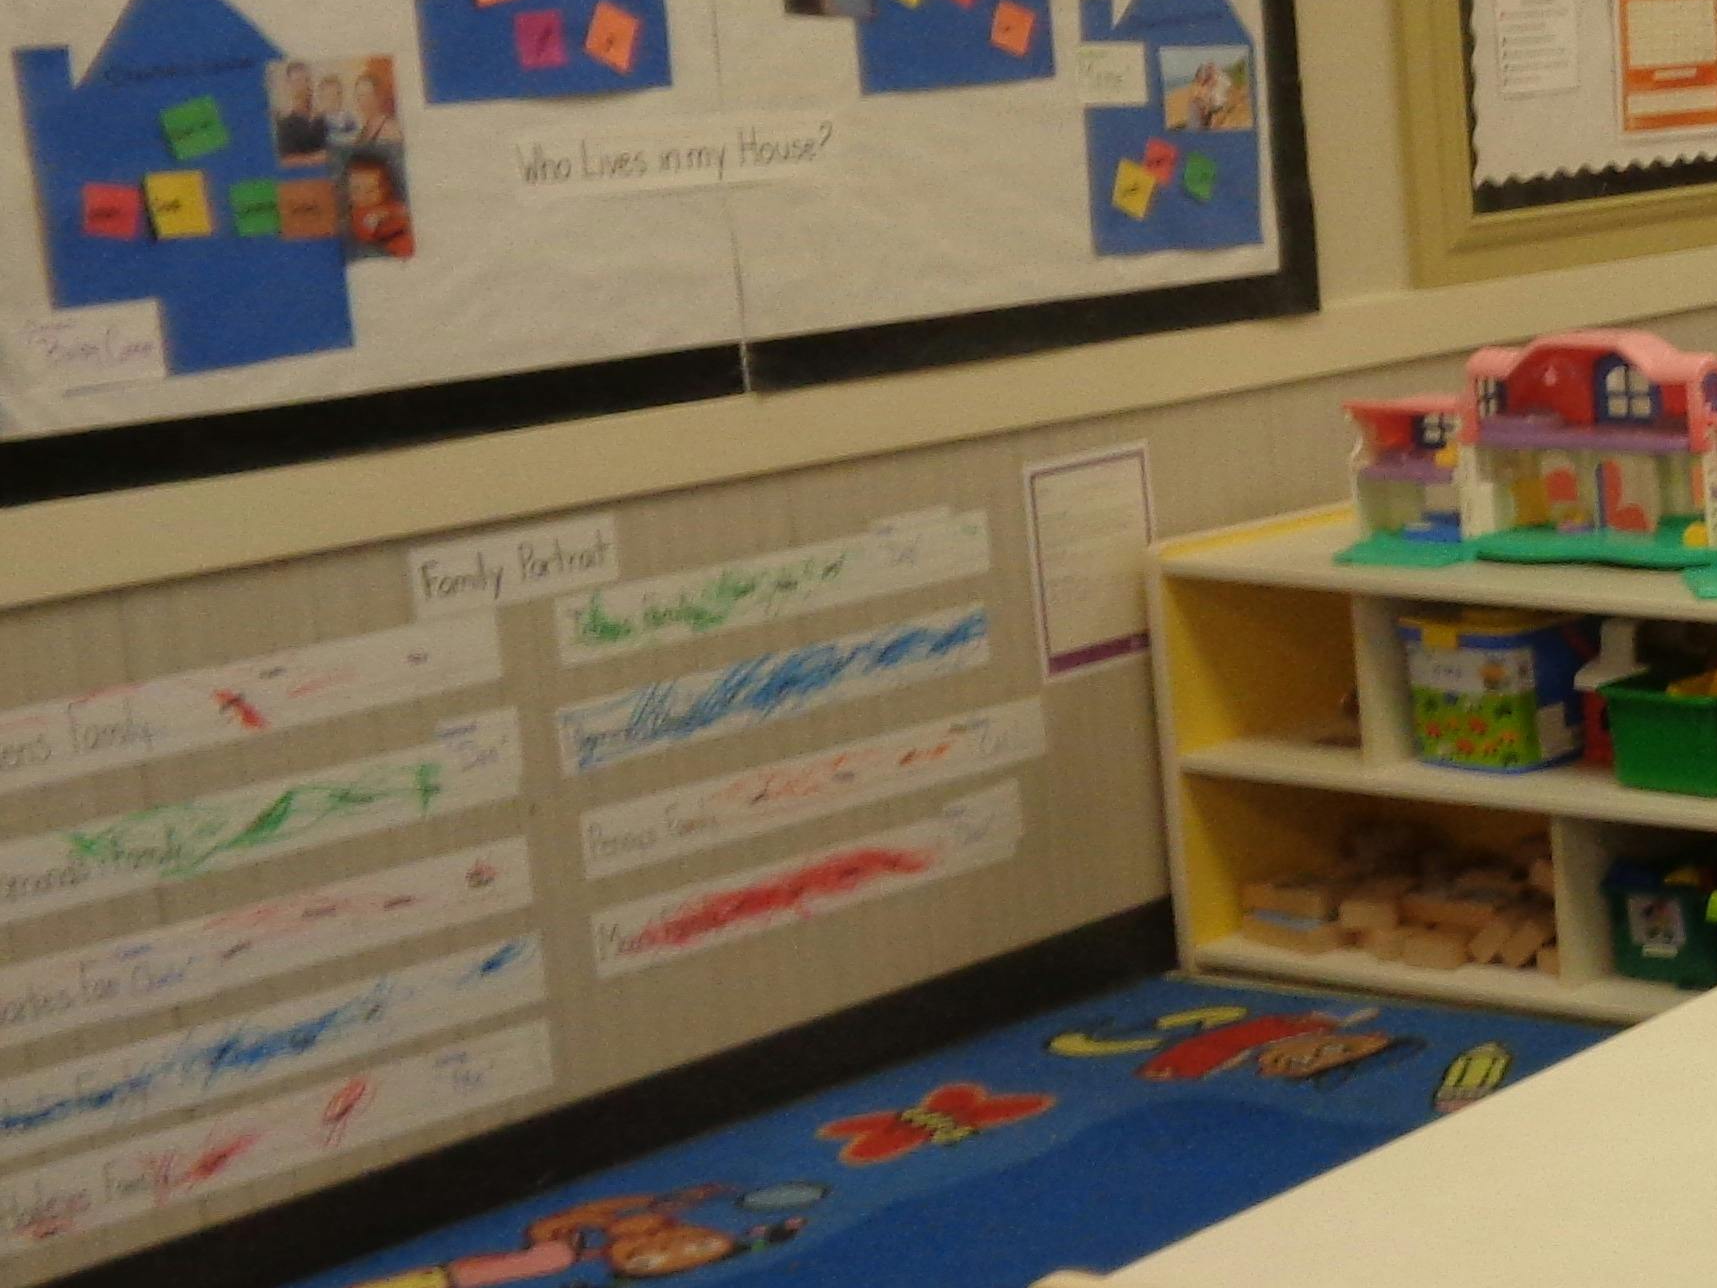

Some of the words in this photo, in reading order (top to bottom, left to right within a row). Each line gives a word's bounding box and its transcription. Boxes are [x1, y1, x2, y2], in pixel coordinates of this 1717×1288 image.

[515, 140, 572, 184] Who
[581, 139, 648, 179] Lives
[659, 149, 681, 173] in
[687, 143, 726, 180] my
[737, 121, 833, 167] House?
[419, 551, 503, 599] Family
[517, 529, 611, 583] Portrait
